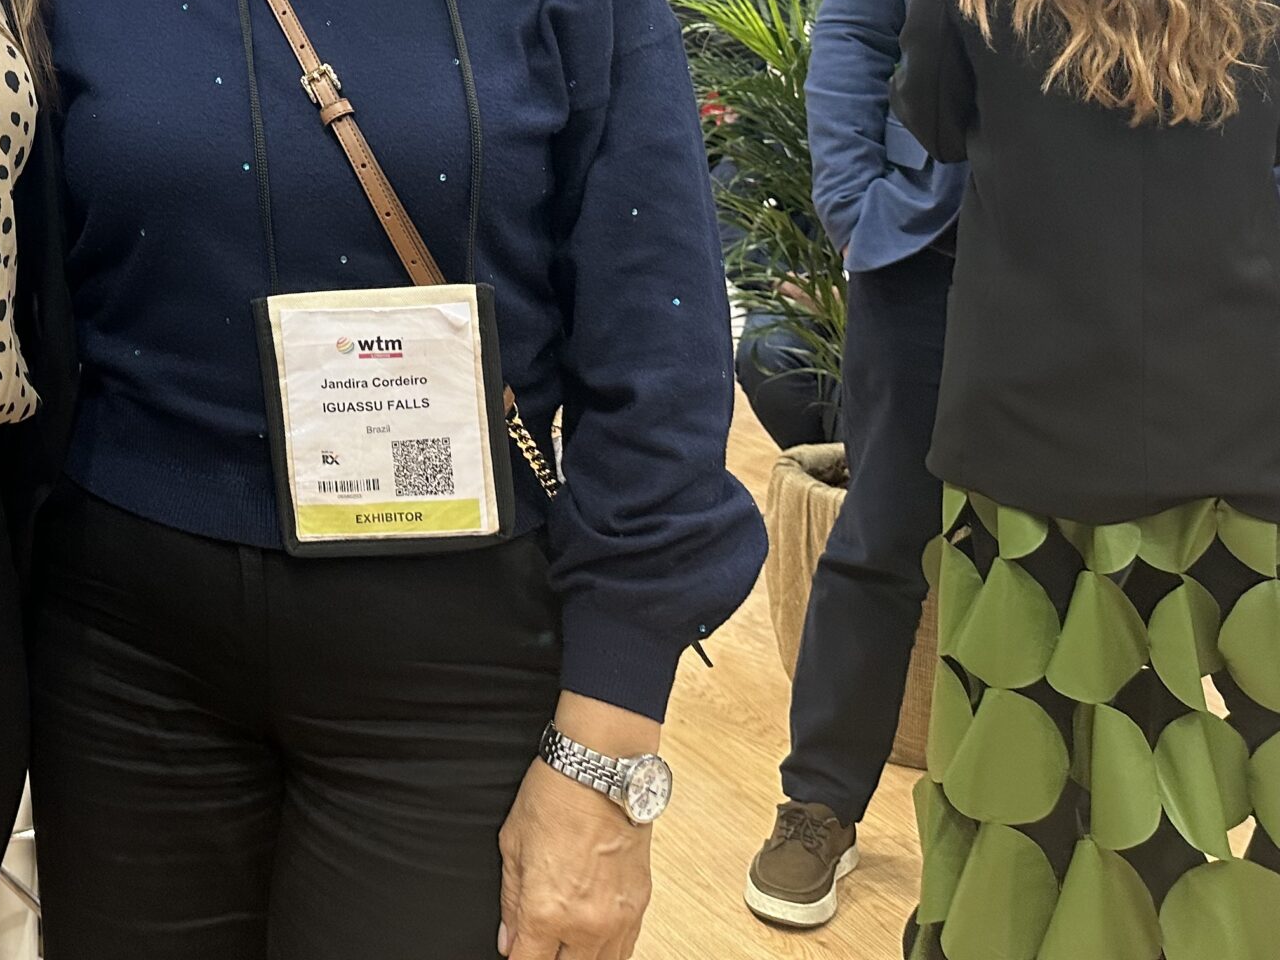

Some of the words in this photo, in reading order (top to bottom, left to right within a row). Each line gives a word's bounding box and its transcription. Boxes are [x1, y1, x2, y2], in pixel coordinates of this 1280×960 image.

[358, 335, 402, 351] wtm
[320, 377, 368, 390] Jandira
[372, 375, 428, 389] Cordeiro
[322, 400, 383, 413] IGUASSU
[387, 397, 430, 411] FALLS
[366, 425, 391, 434] Brazil
[355, 511, 423, 524] EXHIBITOR
